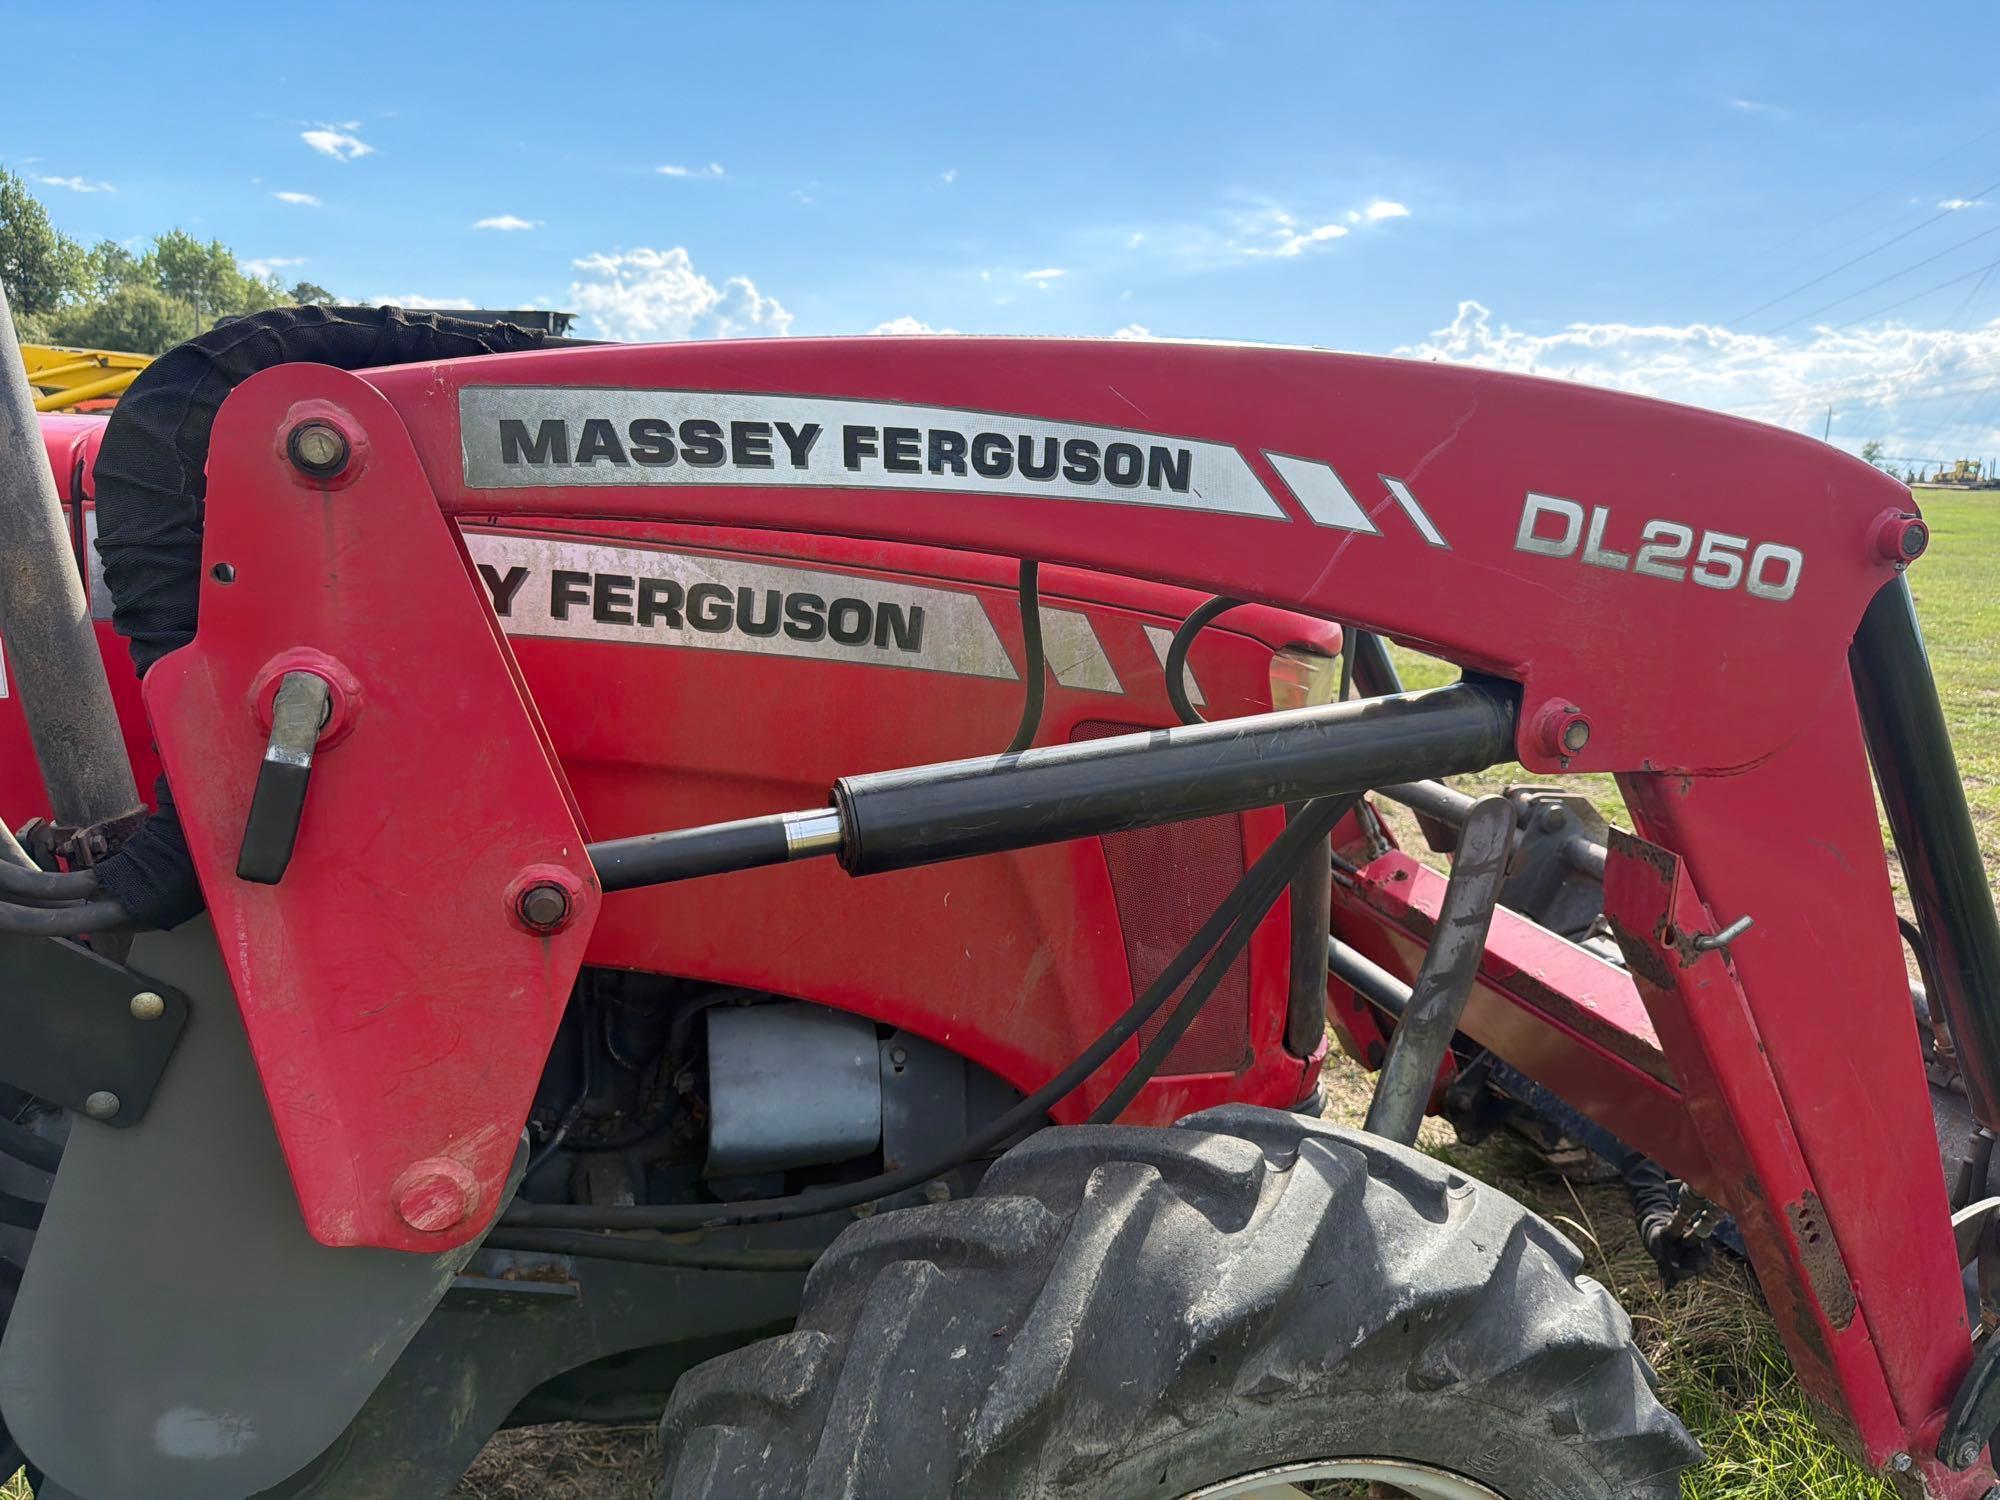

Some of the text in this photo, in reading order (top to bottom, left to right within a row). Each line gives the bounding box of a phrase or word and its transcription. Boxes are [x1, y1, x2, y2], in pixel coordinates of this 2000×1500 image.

[498, 418, 1193, 493] MASSEY FERGUSON
[1515, 491, 1804, 601] DL250
[550, 569, 926, 652] FERGUSON
